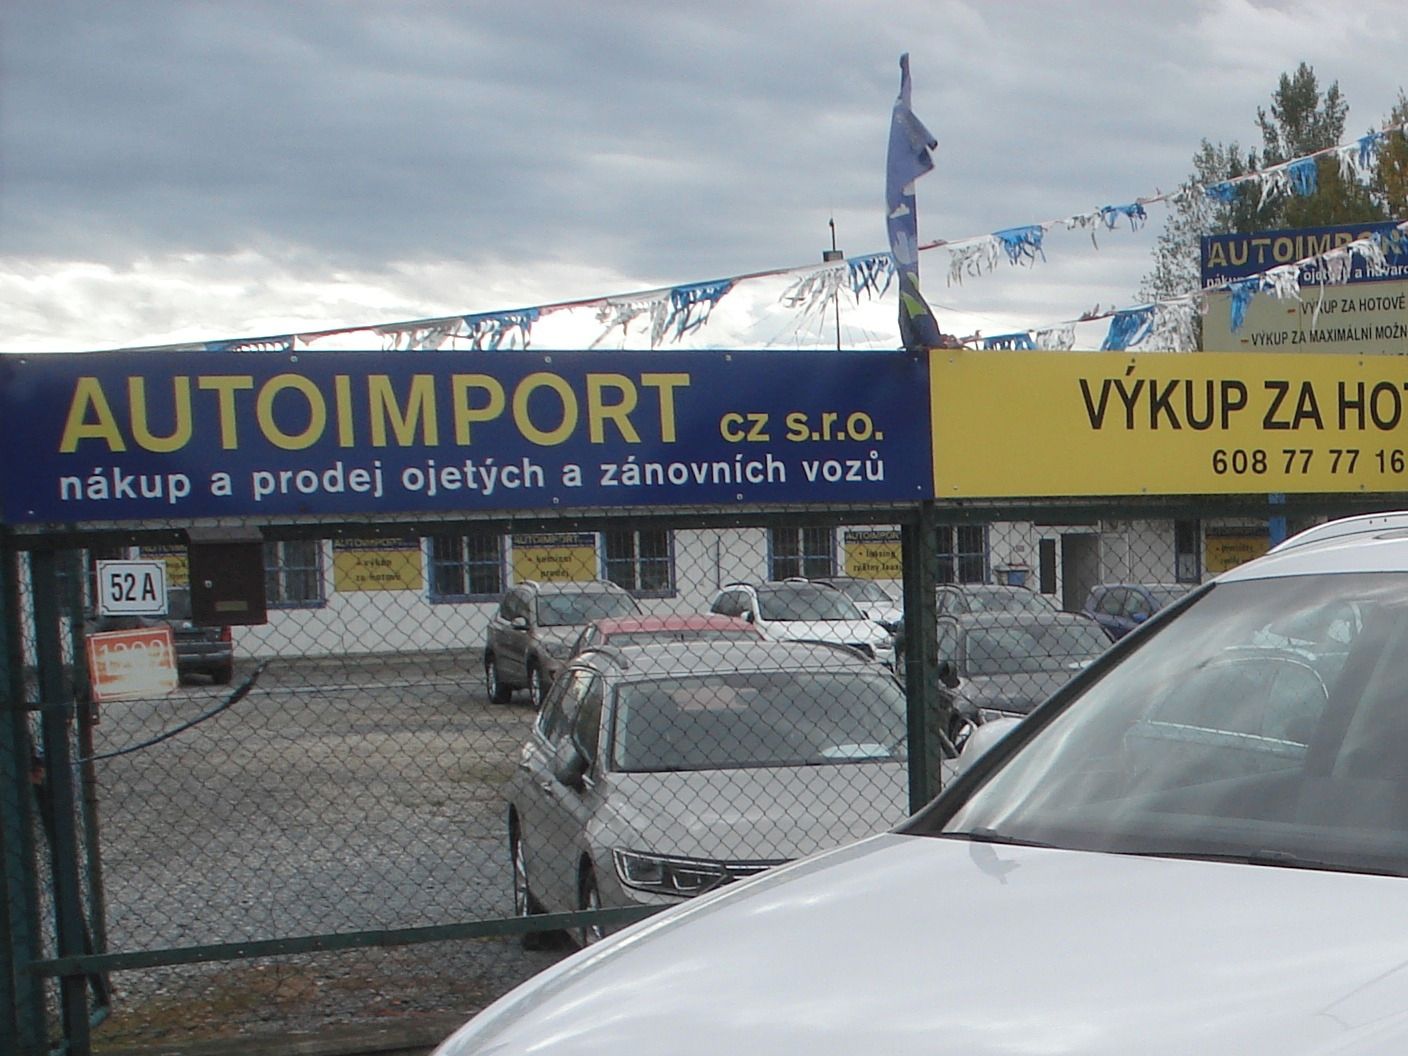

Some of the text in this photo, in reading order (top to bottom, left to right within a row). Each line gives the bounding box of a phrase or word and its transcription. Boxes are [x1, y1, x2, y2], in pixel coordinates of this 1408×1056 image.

[1354, 267, 1364, 279] a
[1301, 294, 1407, 315] VÝKUP ZA HOTOVÉ
[1251, 329, 1289, 346] VÝKUP
[1291, 330, 1307, 345] ZA
[1309, 321, 1373, 344] MAXIMÁLNÍ
[1078, 365, 1250, 431] VÝKUP
[1262, 380, 1325, 431] ZA
[58, 372, 885, 453] AUTOIMPORT cz s.r.o.
[1211, 448, 1406, 475] 608 77 77 16
[59, 449, 885, 505] nákup a prodej ojetých a zánovních vozů
[110, 572, 157, 602] 52 A
